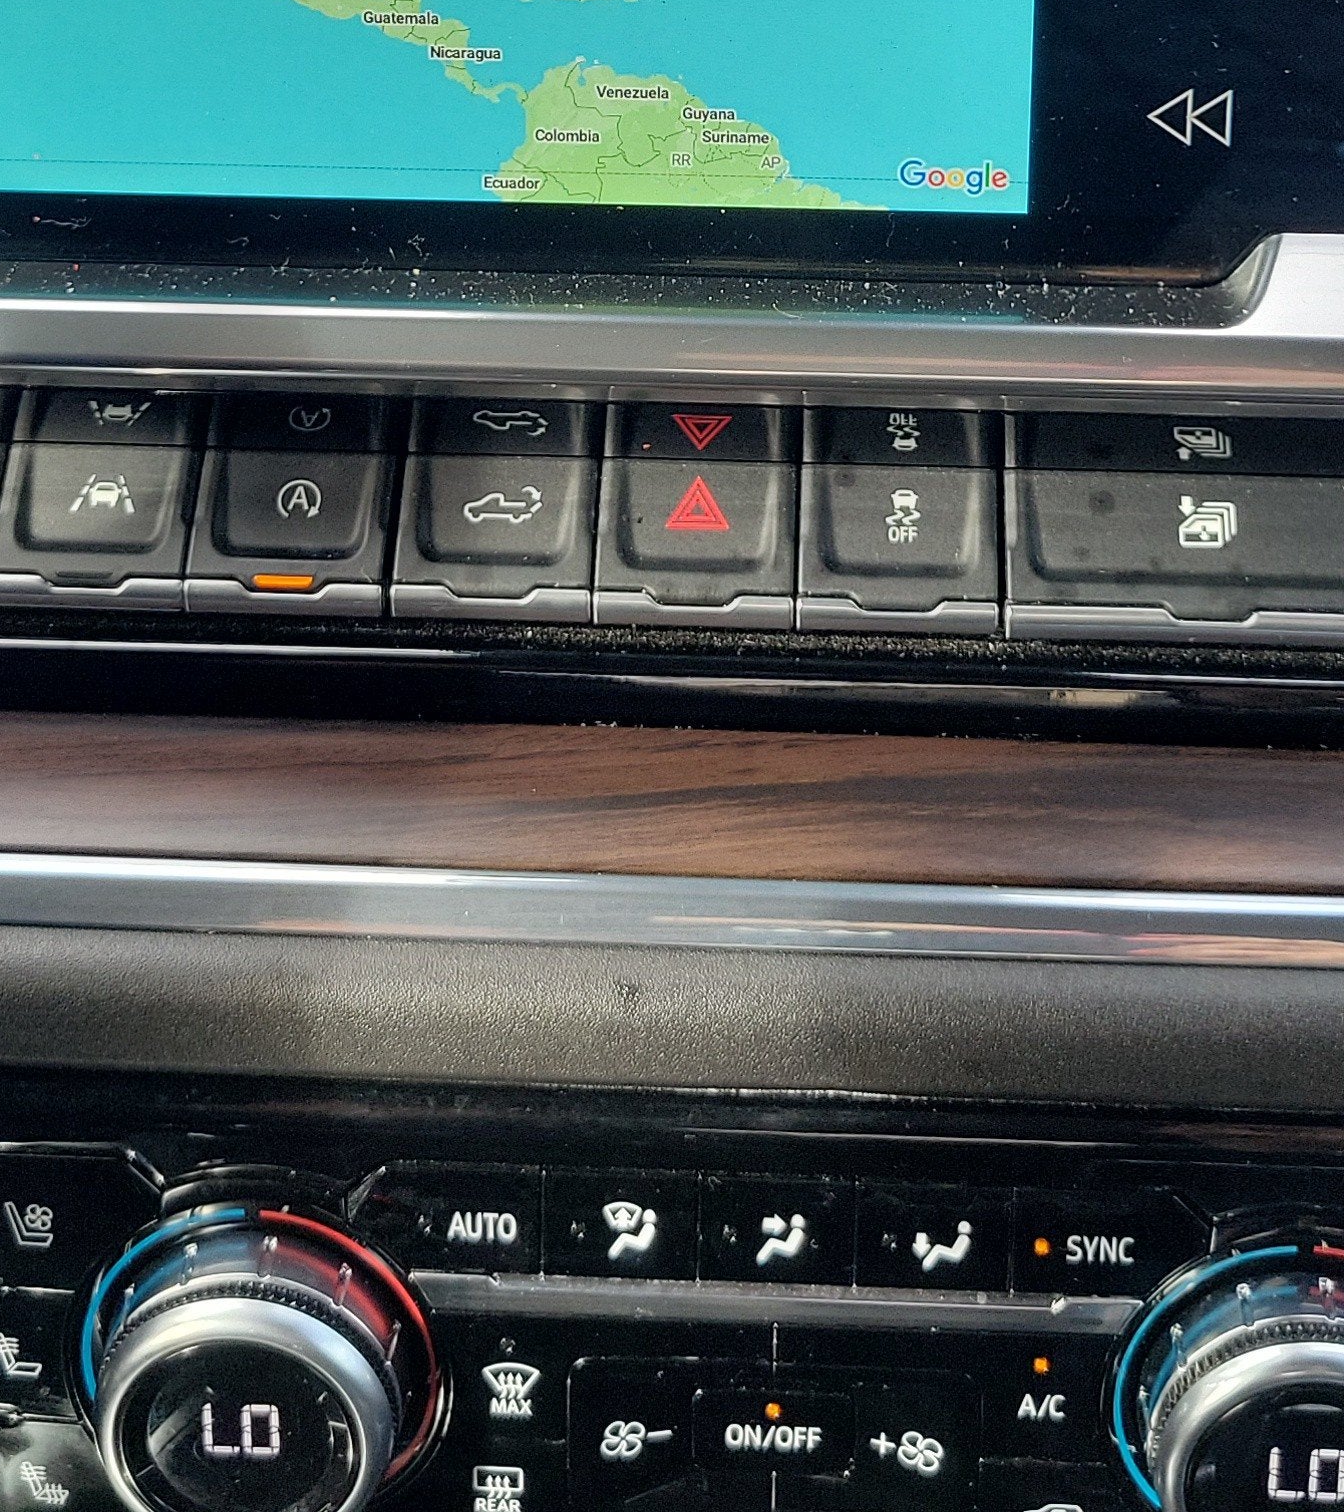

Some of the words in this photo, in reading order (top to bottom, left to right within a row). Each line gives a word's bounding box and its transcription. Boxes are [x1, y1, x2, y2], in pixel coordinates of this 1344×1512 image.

[363, 11, 439, 25] Guatemala
[430, 46, 501, 62] Nicaragua
[596, 86, 669, 101] Venezuela
[682, 106, 735, 123] Guyana
[535, 129, 600, 143] Colombia
[702, 130, 769, 145] Suriname
[671, 153, 691, 166] RR
[761, 156, 781, 169] AP
[483, 176, 540, 190] Ecuador
[899, 159, 1008, 196] Google
[887, 525, 919, 544] OFF
[447, 1211, 517, 1243] AUTO
[1065, 1234, 1135, 1267] SYNC
[489, 1396, 534, 1418] MAX
[1018, 1393, 1066, 1421] A/C
[200, 1401, 281, 1458] LO
[724, 1422, 822, 1453] ON/OFF
[473, 1497, 522, 1512] REAR
